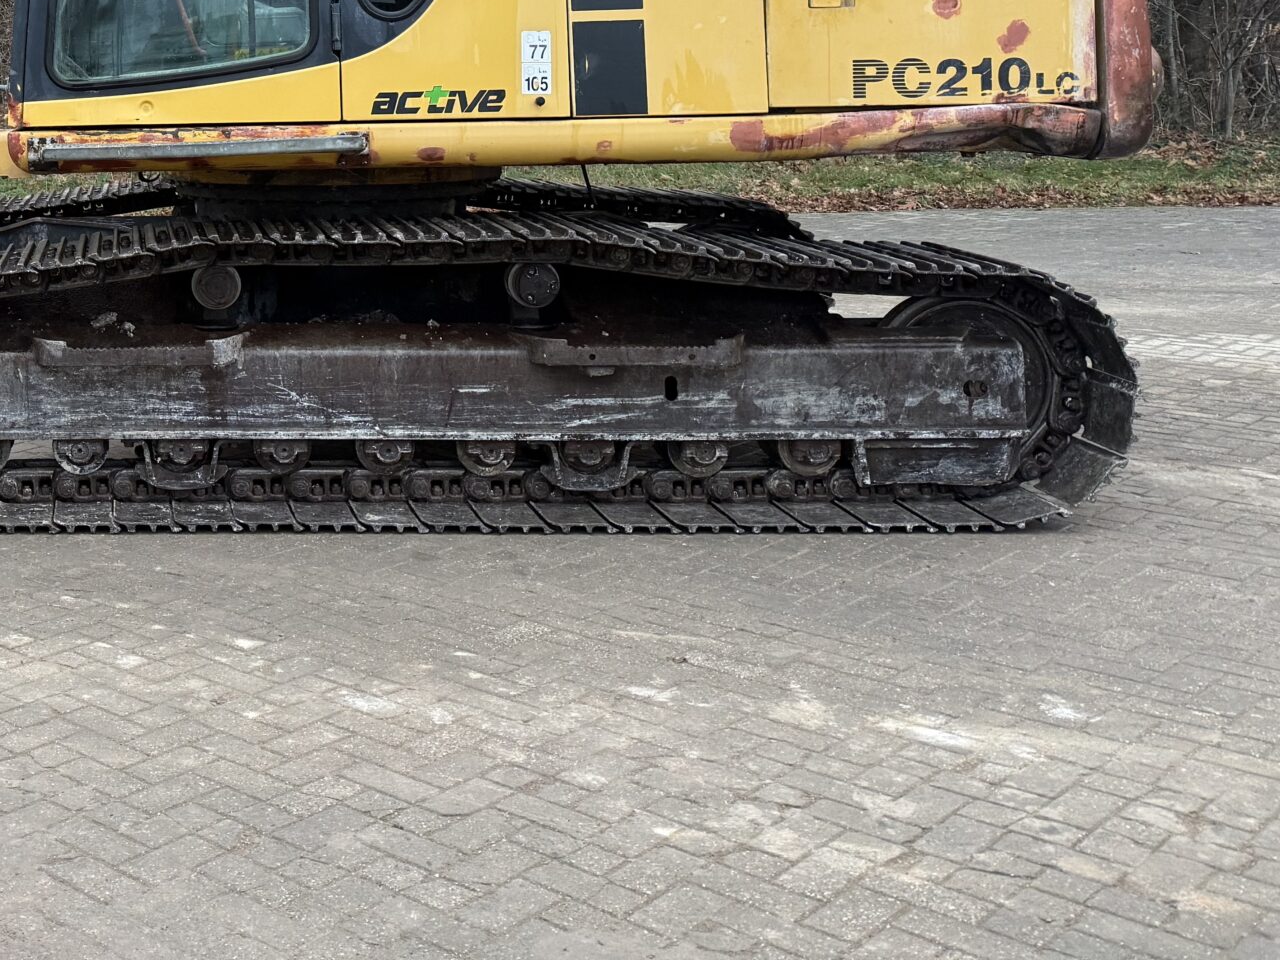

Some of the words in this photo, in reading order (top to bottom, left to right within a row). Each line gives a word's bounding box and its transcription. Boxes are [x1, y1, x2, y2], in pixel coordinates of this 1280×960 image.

[529, 44, 547, 59] 77
[524, 76, 549, 92] 105
[370, 85, 506, 115] active
